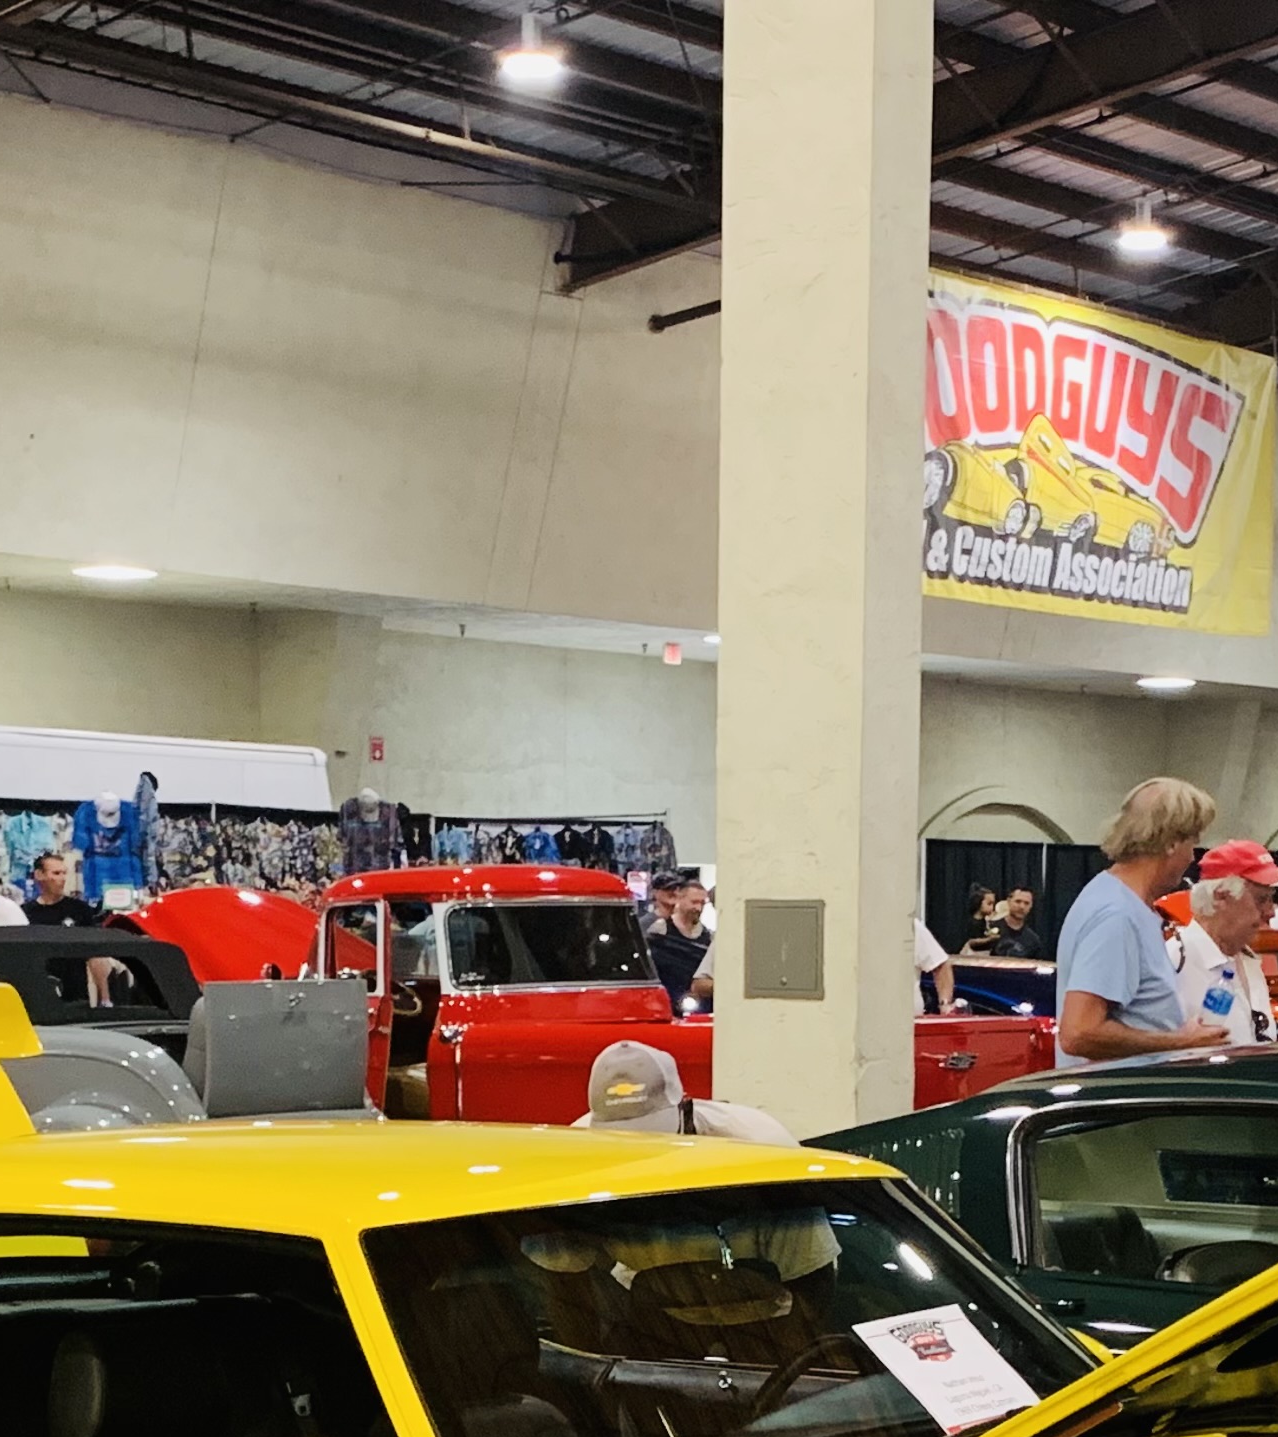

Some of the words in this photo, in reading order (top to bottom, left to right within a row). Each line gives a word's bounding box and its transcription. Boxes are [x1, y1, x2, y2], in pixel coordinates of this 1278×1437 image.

[927, 529, 949, 572] &
[953, 525, 1053, 588] Custom
[1053, 542, 1192, 608] Association
